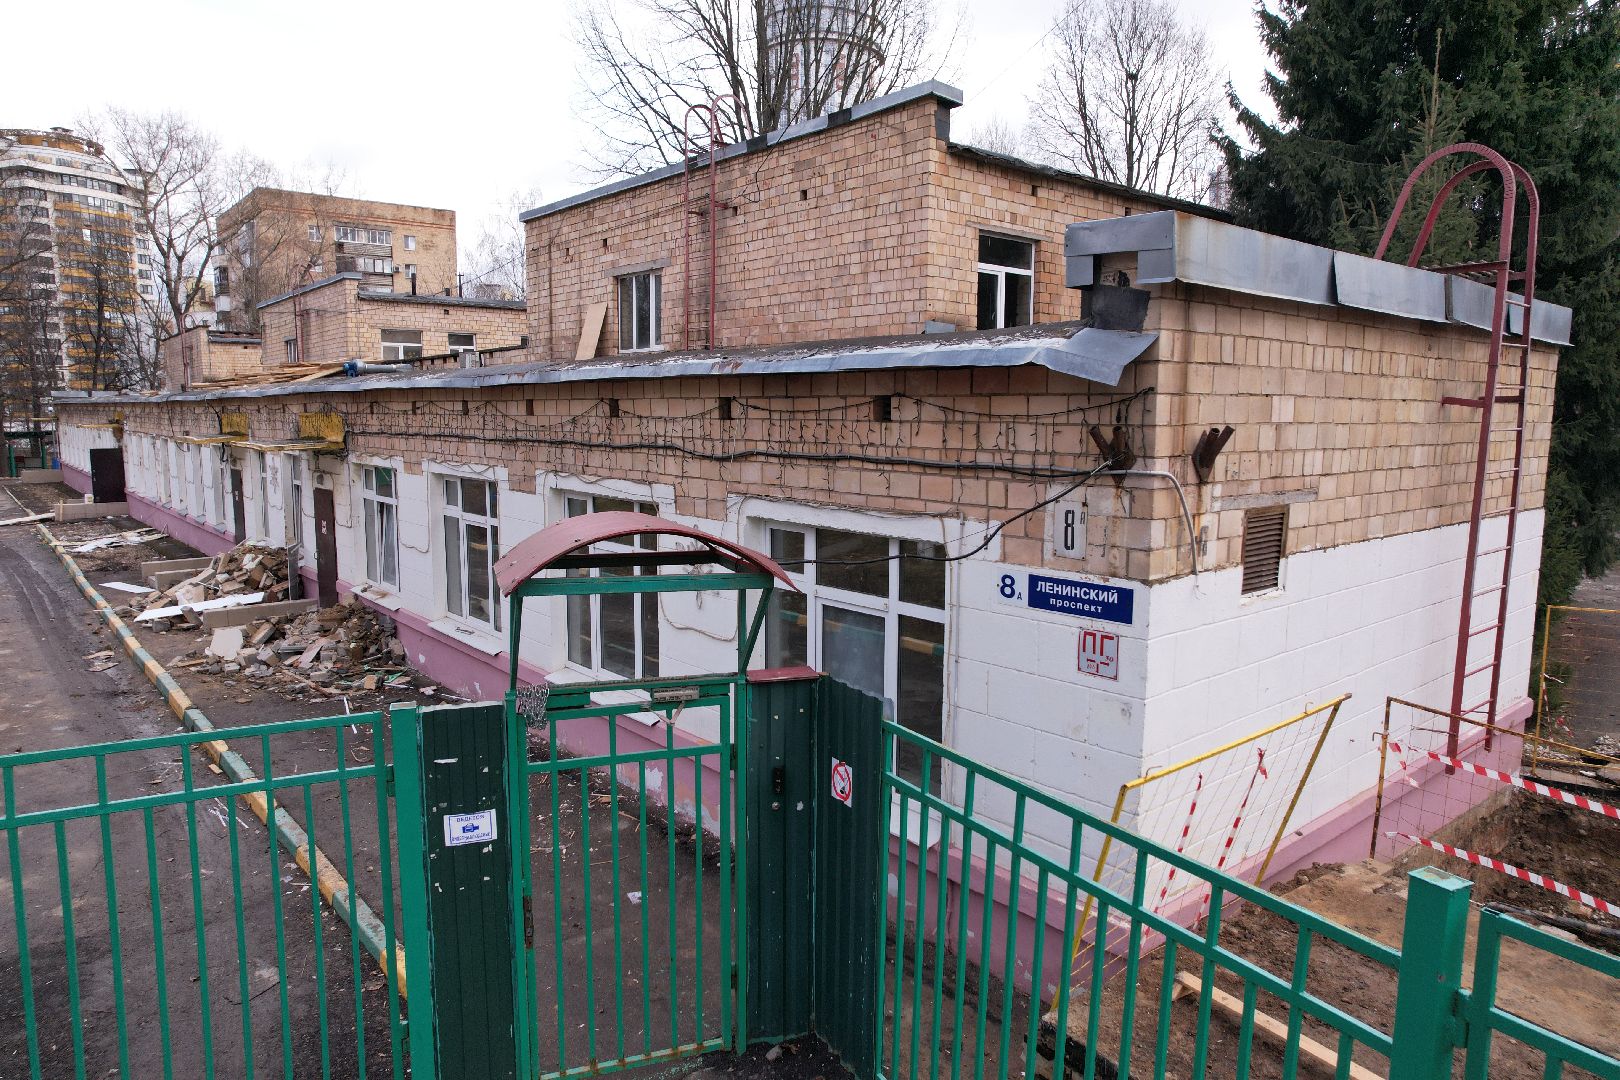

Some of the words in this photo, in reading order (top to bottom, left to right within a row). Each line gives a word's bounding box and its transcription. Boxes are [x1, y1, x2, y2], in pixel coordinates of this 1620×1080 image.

[1036, 580, 1118, 604] ЛЕНИНСКИЙ
[1050, 597, 1103, 613] проспект
[1083, 631, 1114, 656] ПГ
